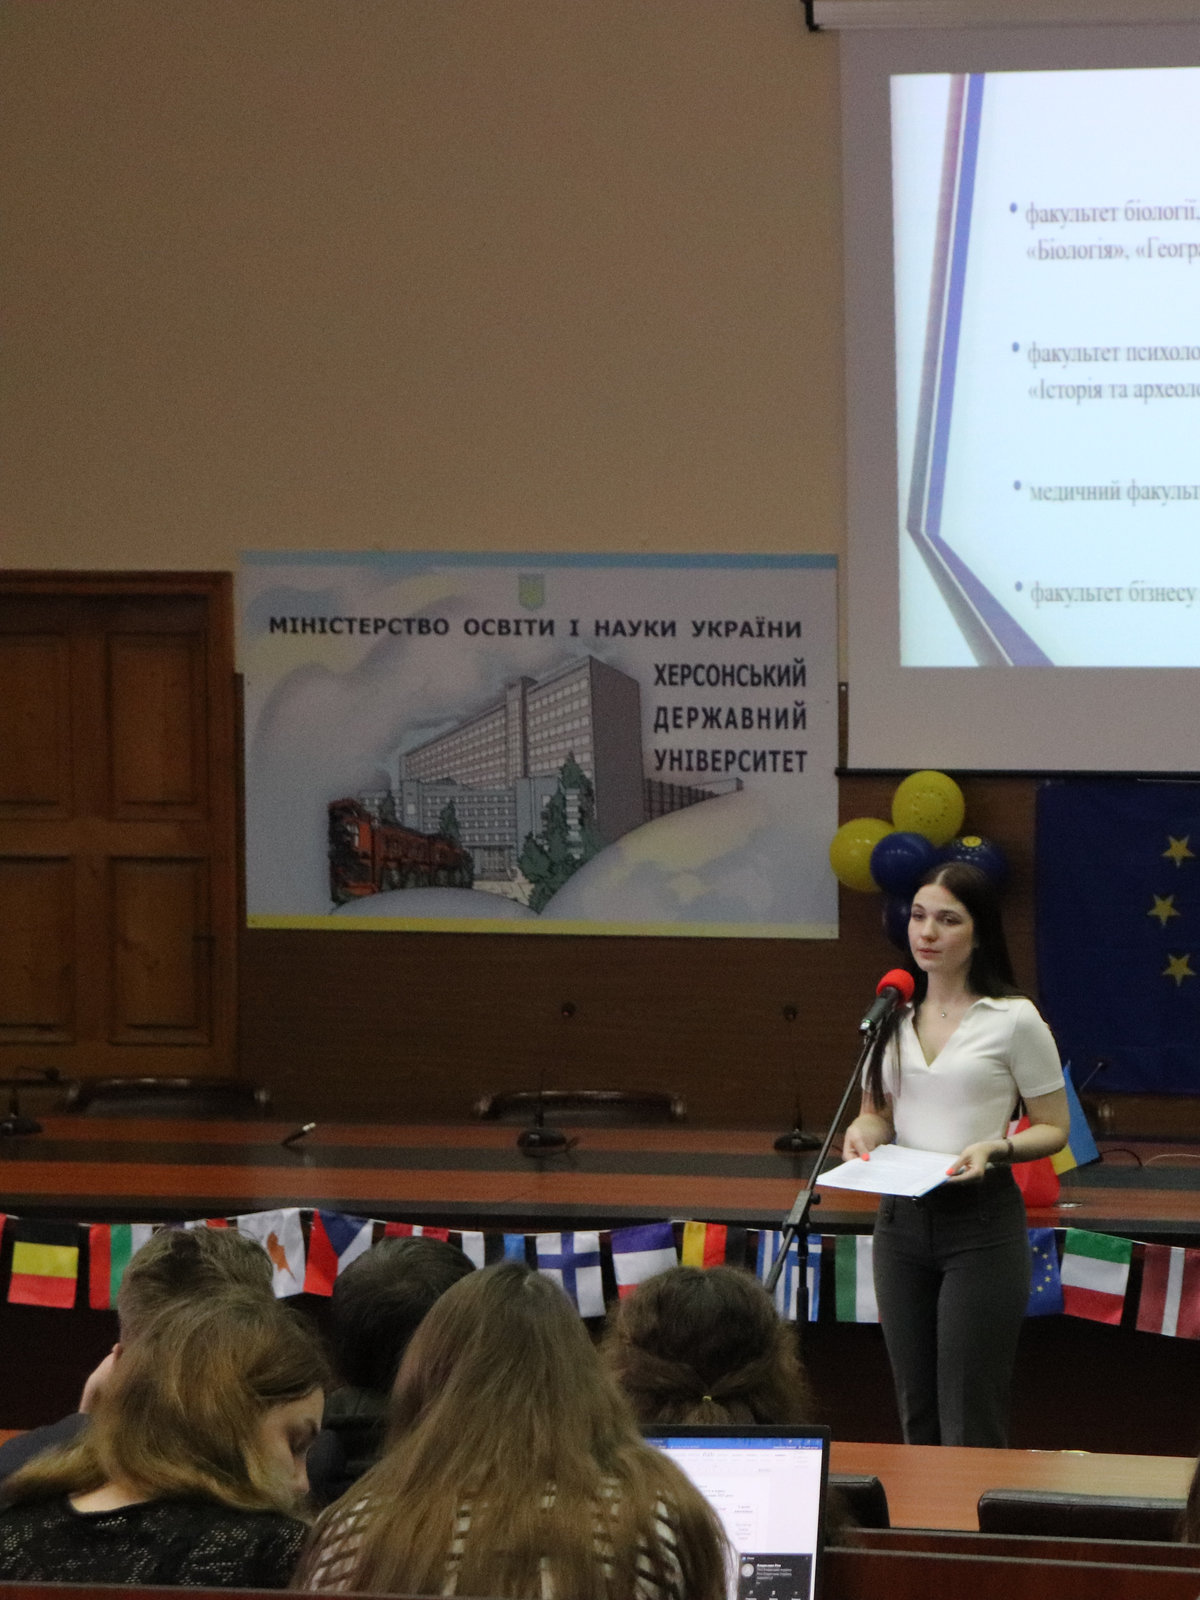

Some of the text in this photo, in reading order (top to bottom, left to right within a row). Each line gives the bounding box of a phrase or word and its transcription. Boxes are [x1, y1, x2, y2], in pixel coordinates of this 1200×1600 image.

[1025, 200, 1117, 229] факультет
[1028, 341, 1121, 368] факультет
[1028, 377, 1102, 404] «Історія
[1107, 382, 1128, 399] та
[1030, 479, 1121, 500] медичний
[1030, 580, 1123, 607] факультет
[1128, 581, 1195, 609] бізнесу
[269, 615, 802, 639] МІНІСТЕРСТВО ОСВІТИ І НАУКИ УКРАЇНИ
[654, 658, 806, 688] ХЕРСОНСЬКИЙ
[653, 702, 807, 733] ДЕРЖАВНИЙ
[654, 748, 807, 773] УНІВЕРСИТЕТ
